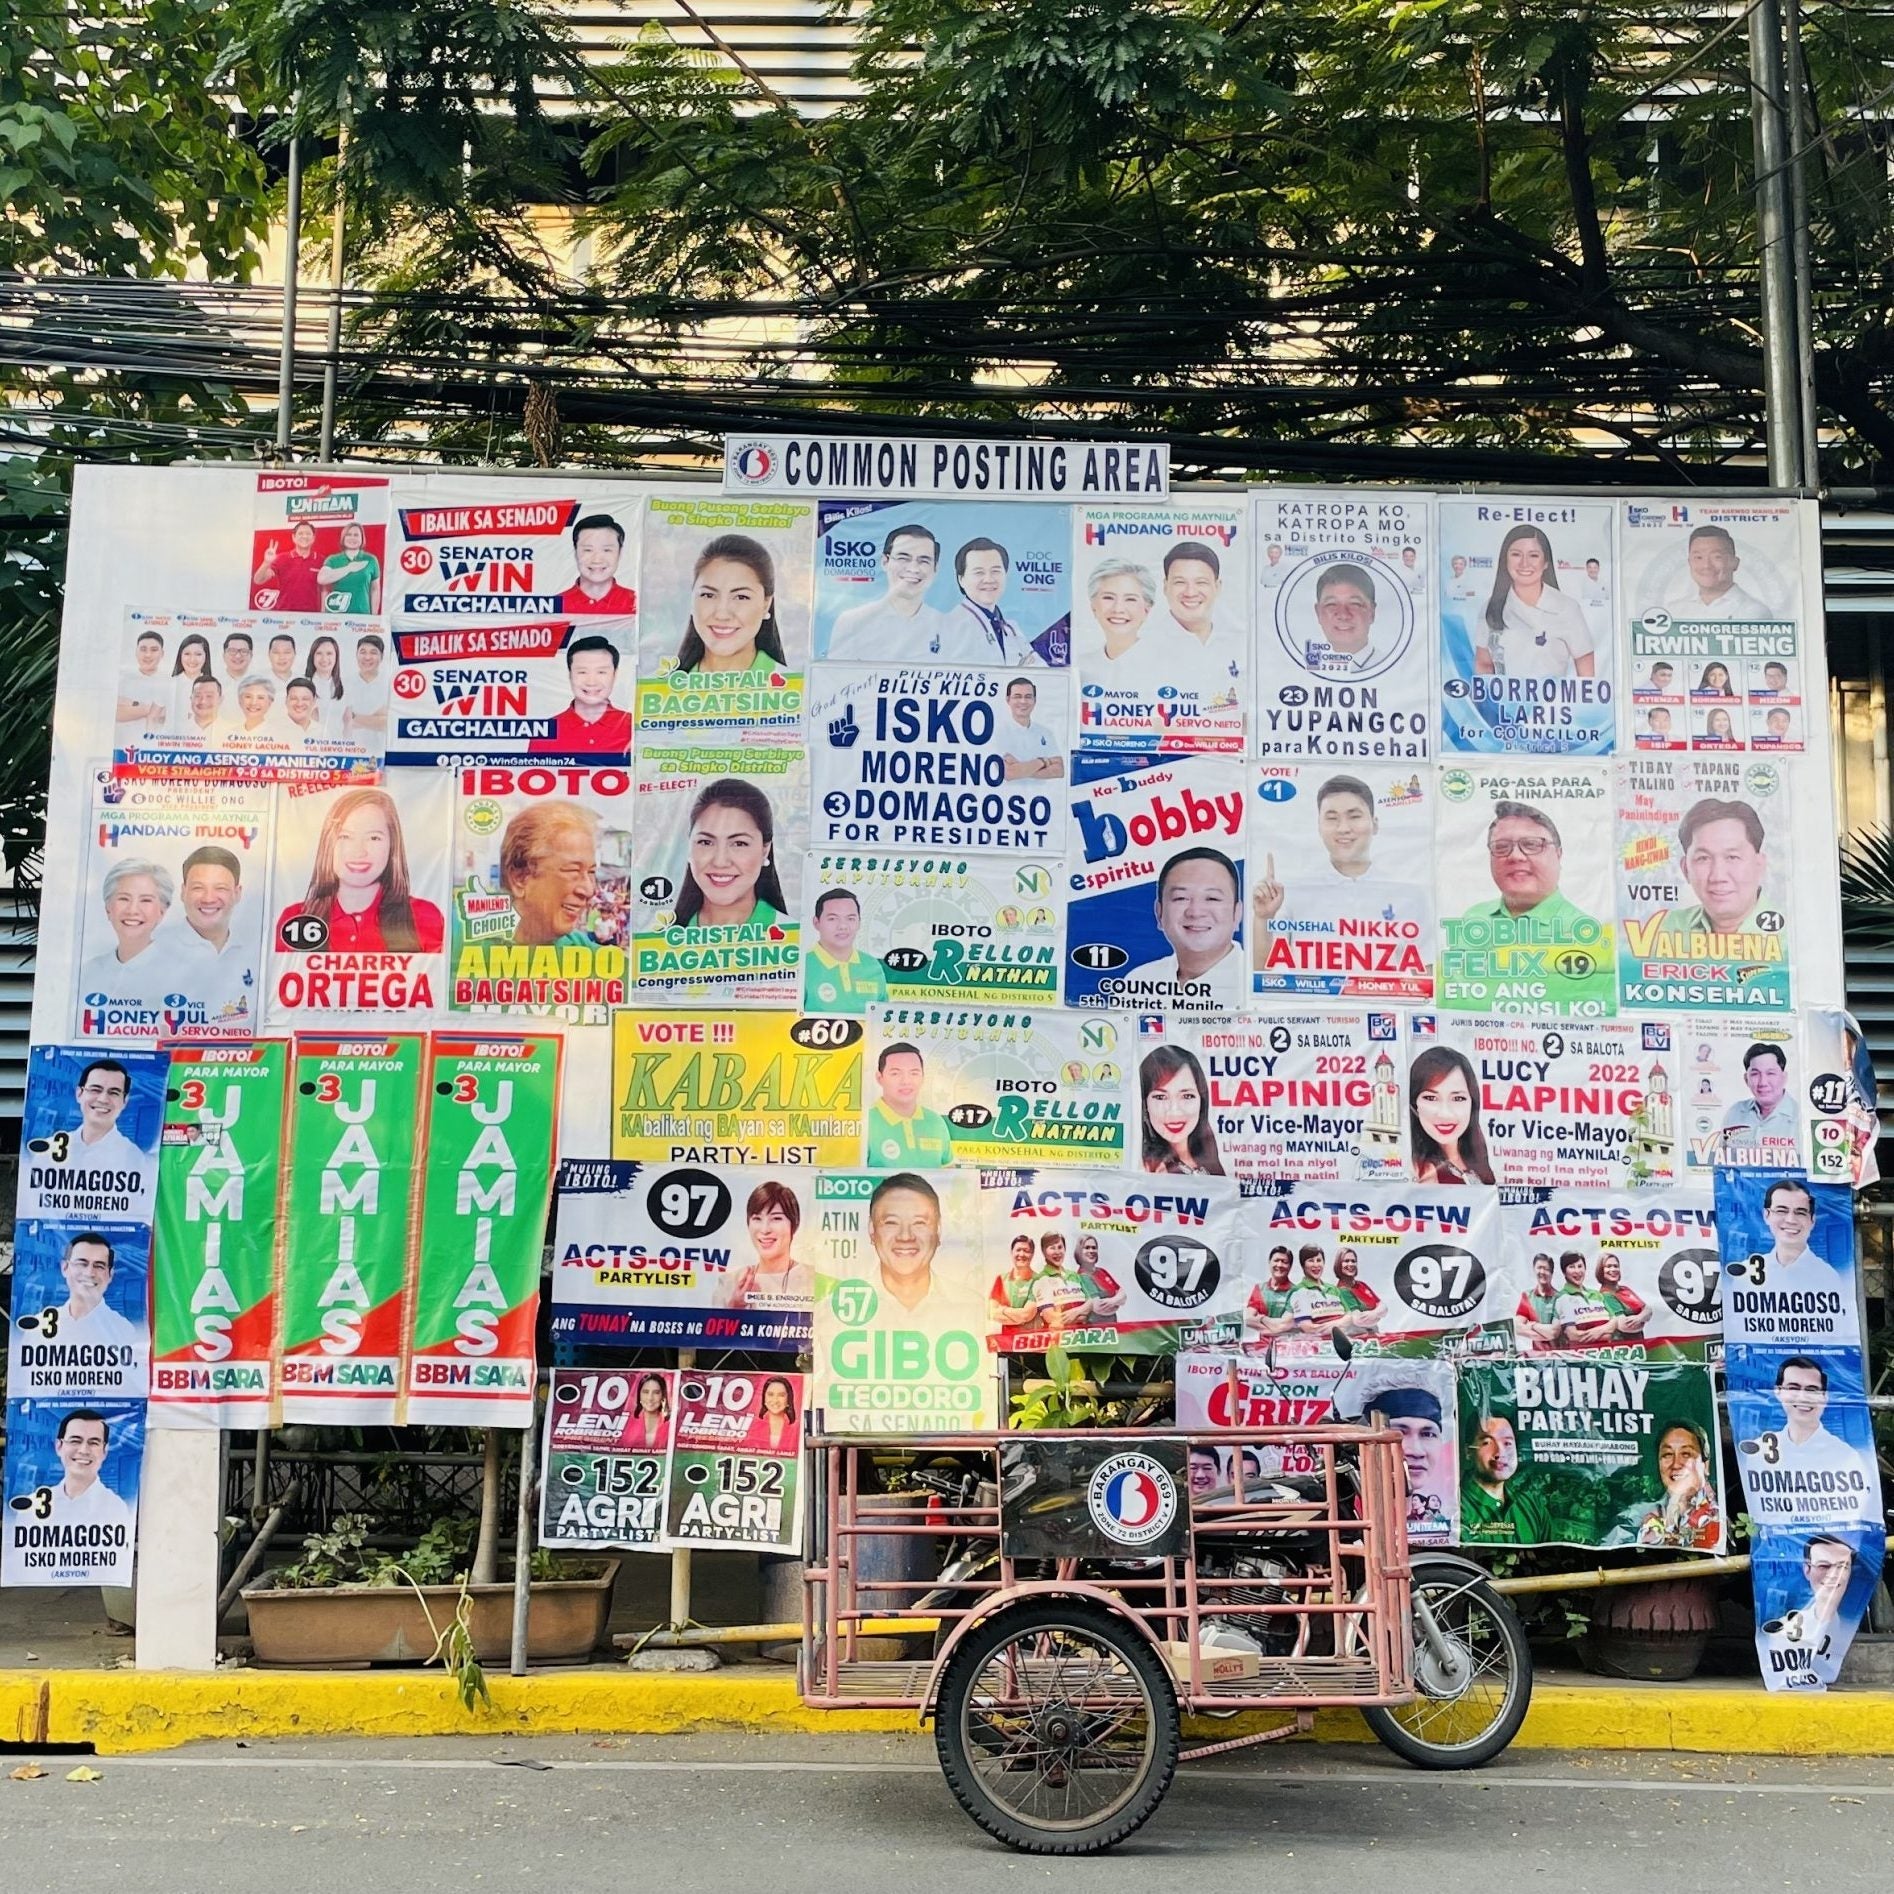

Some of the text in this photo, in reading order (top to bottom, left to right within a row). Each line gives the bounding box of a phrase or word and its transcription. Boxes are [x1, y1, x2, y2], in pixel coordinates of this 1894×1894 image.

[786, 442, 1162, 491] COMMON POSTING AREA
[421, 506, 557, 532] IBALIK SA SENADO
[1113, 512, 1170, 521] PROGRAMA
[1173, 513, 1189, 521] NG
[1191, 512, 1237, 525] MAYNILA
[1278, 504, 1368, 515] KATROPA
[1478, 507, 1576, 523] Re-Elect!
[1278, 518, 1405, 531] KATROPA MO
[826, 536, 875, 557] ISKO
[1291, 532, 1355, 543] Distrito
[1365, 534, 1421, 546] Singko
[404, 547, 533, 570] 30 SENATOR
[825, 559, 875, 568] MORENO
[1026, 552, 1052, 560] DOC
[1313, 553, 1338, 565] BILIS
[1016, 562, 1062, 573] WILLIE
[440, 562, 532, 593] WIN
[1024, 574, 1055, 585] ONG
[412, 596, 555, 613] GATCHALIAN
[1656, 614, 1668, 627] 2
[1679, 624, 1791, 634] CONGRESSMAN
[1636, 634, 1794, 655] IRWIN TIENG
[669, 671, 767, 691] CRISTAL
[899, 670, 987, 682] PILIPINAS
[878, 678, 998, 696] BILIS KILOS
[1104, 691, 1138, 699] MAYOR
[1472, 677, 1611, 705] BORROMEO
[642, 691, 800, 715] BAGATSING
[1284, 687, 1377, 709] 23 MON
[641, 716, 754, 731] Congresswoman
[876, 697, 994, 747] ISKO
[1104, 718, 1241, 729] LACUNA SERVO NIETO
[1267, 710, 1425, 735] YUPANGCO
[1499, 705, 1573, 726] LARIS
[1460, 727, 1600, 742] for COUNCILOR
[1262, 736, 1427, 758] para Konsehal
[174, 755, 200, 765] ANG
[490, 757, 576, 766] WinGatchalian74
[861, 750, 1005, 787] MORENO
[1629, 762, 1740, 776] TIBAY TAPANG
[138, 767, 330, 780] VOTE DISTRITO
[1261, 768, 1290, 776] VOTE
[639, 779, 697, 792] RE-ELECT!
[1480, 777, 1591, 788] PAG-ASA PARA
[1630, 778, 1739, 793] TALINO TAPAT
[1490, 787, 1606, 801] SA HINAHARAP
[854, 789, 1051, 826] DOMAGOSO
[1071, 788, 1244, 864] bobby
[829, 824, 1047, 849] FOR PRESIDENT
[1070, 861, 1154, 891] espiritu
[1628, 885, 1678, 901] VOTE!
[473, 914, 515, 935] CHOICE
[932, 924, 991, 937] IBOTO
[1268, 919, 1419, 939] KONSEHAL NIKKO
[1760, 913, 1780, 929] 21
[285, 921, 322, 942] 16
[1441, 917, 1602, 949] TOBILLO
[1623, 909, 1783, 961] VALBUENA
[306, 955, 413, 970] CHARRY
[457, 945, 624, 979] AMADO
[887, 953, 923, 967] #17
[1265, 938, 1426, 972] ATIENZA
[965, 964, 1050, 983] NATHAN
[1441, 951, 1548, 979] FELIX
[1643, 963, 1729, 981] ERICK
[278, 972, 434, 1008] ORTEGA
[456, 979, 623, 1004] BAGATSING
[1099, 979, 1211, 996] COUNCILOR
[1262, 978, 1394, 990] ISKO WILLIE HONEY
[1444, 981, 1547, 999] ETO ANG
[920, 989, 979, 1000] KONSEHAL
[1624, 984, 1784, 1004] KONSEHAL
[638, 1024, 704, 1043] VOTE
[1298, 1034, 1351, 1048] SA BALOTA
[457, 1060, 541, 1073] PARA MAYOR
[1210, 1056, 1366, 1077] LUCY 2022
[619, 1052, 862, 1112] KABAKA
[1210, 1080, 1373, 1107] LAPINIG
[768, 1119, 785, 1137] sa
[1217, 1115, 1364, 1138] for Vice-Mayor
[1822, 1128, 1839, 1140] 10
[1820, 1155, 1843, 1168] 152
[30, 1168, 145, 1195] DOMAGOSO,
[39, 1194, 129, 1211] ISKO MORENO
[660, 1184, 719, 1227] 97
[452, 1080, 517, 1357] JAMIAS
[822, 1212, 859, 1232] ATIN
[561, 1243, 732, 1273] ACTS-OFW
[1148, 1245, 1208, 1292] 97
[600, 1271, 692, 1286] PARTYLIST
[1733, 1291, 1846, 1316] DOMAGOSO,
[552, 1313, 753, 1337] ANG TUNAY NA BOSES NG OFW SA
[1745, 1317, 1834, 1332] ISKO MORENO
[831, 1330, 980, 1381] GIBO
[415, 1364, 526, 1387] BBM SARA
[705, 1376, 754, 1412] 10
[1284, 1385, 1319, 1397] RON
[1513, 1366, 1652, 1409] BUHAY
[1517, 1410, 1654, 1434] PARTY-LIST
[1094, 1458, 1171, 1500] BARANGAY 669
[681, 1492, 783, 1530] AGRI
[679, 1525, 780, 1543] PARTY-LIST
